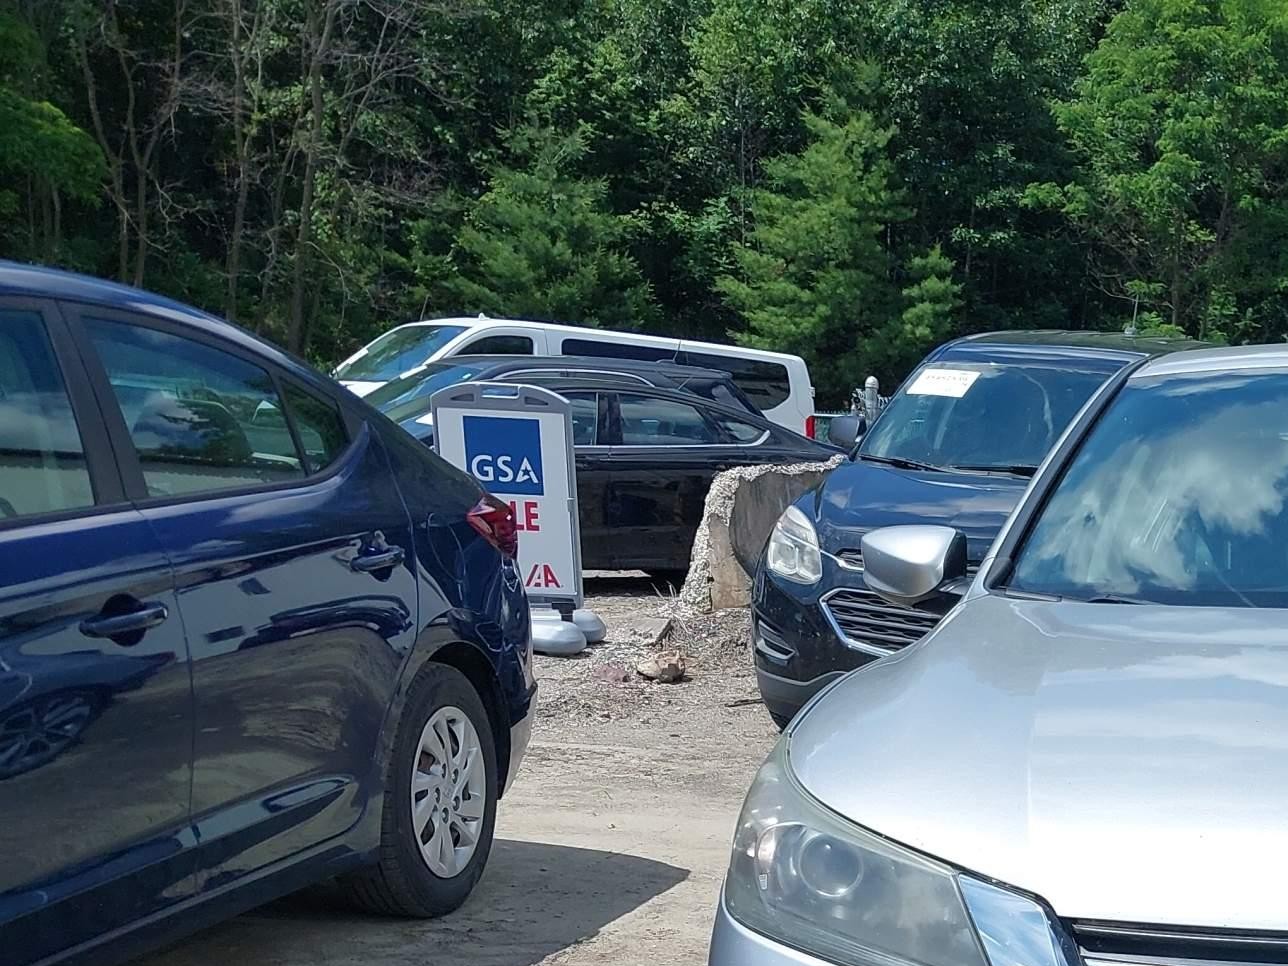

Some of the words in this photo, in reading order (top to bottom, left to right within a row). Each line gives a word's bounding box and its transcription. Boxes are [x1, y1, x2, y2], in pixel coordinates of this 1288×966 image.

[472, 455, 538, 483] GSA
[510, 500, 540, 532] LE
[525, 564, 561, 588] AA
